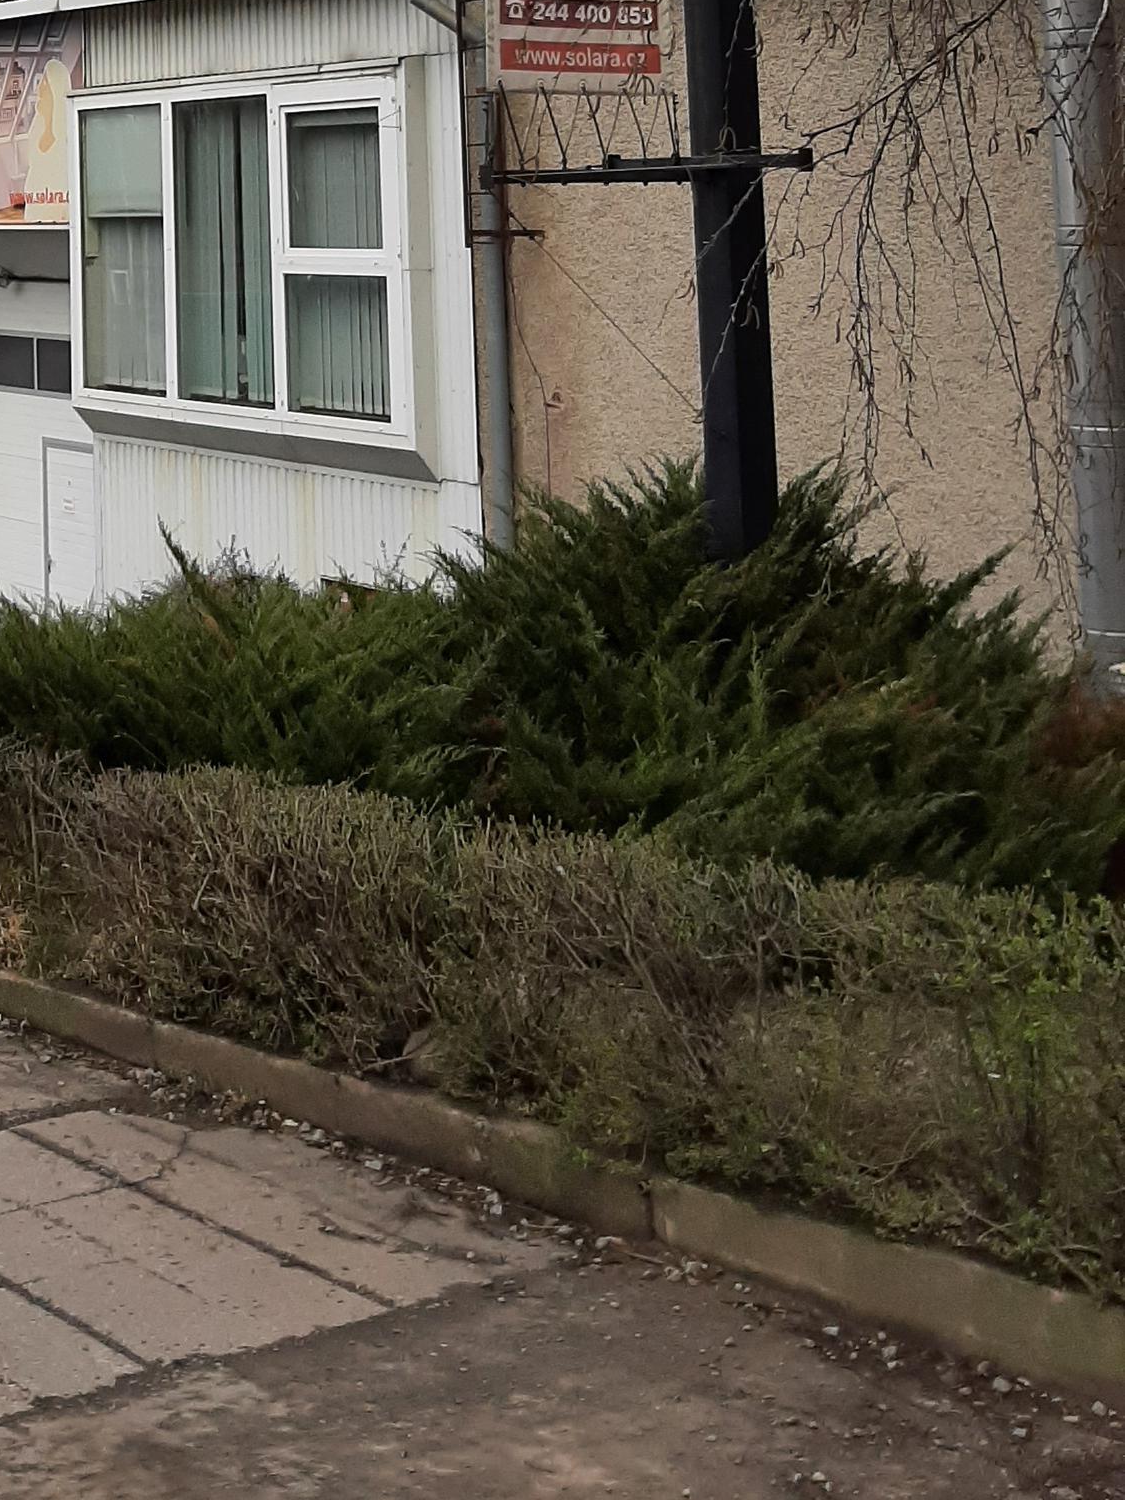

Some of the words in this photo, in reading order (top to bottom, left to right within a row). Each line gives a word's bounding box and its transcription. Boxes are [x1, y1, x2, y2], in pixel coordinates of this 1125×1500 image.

[532, 2, 569, 21] 244
[574, 4, 611, 23] 400
[514, 47, 648, 68] www.solara.cz
